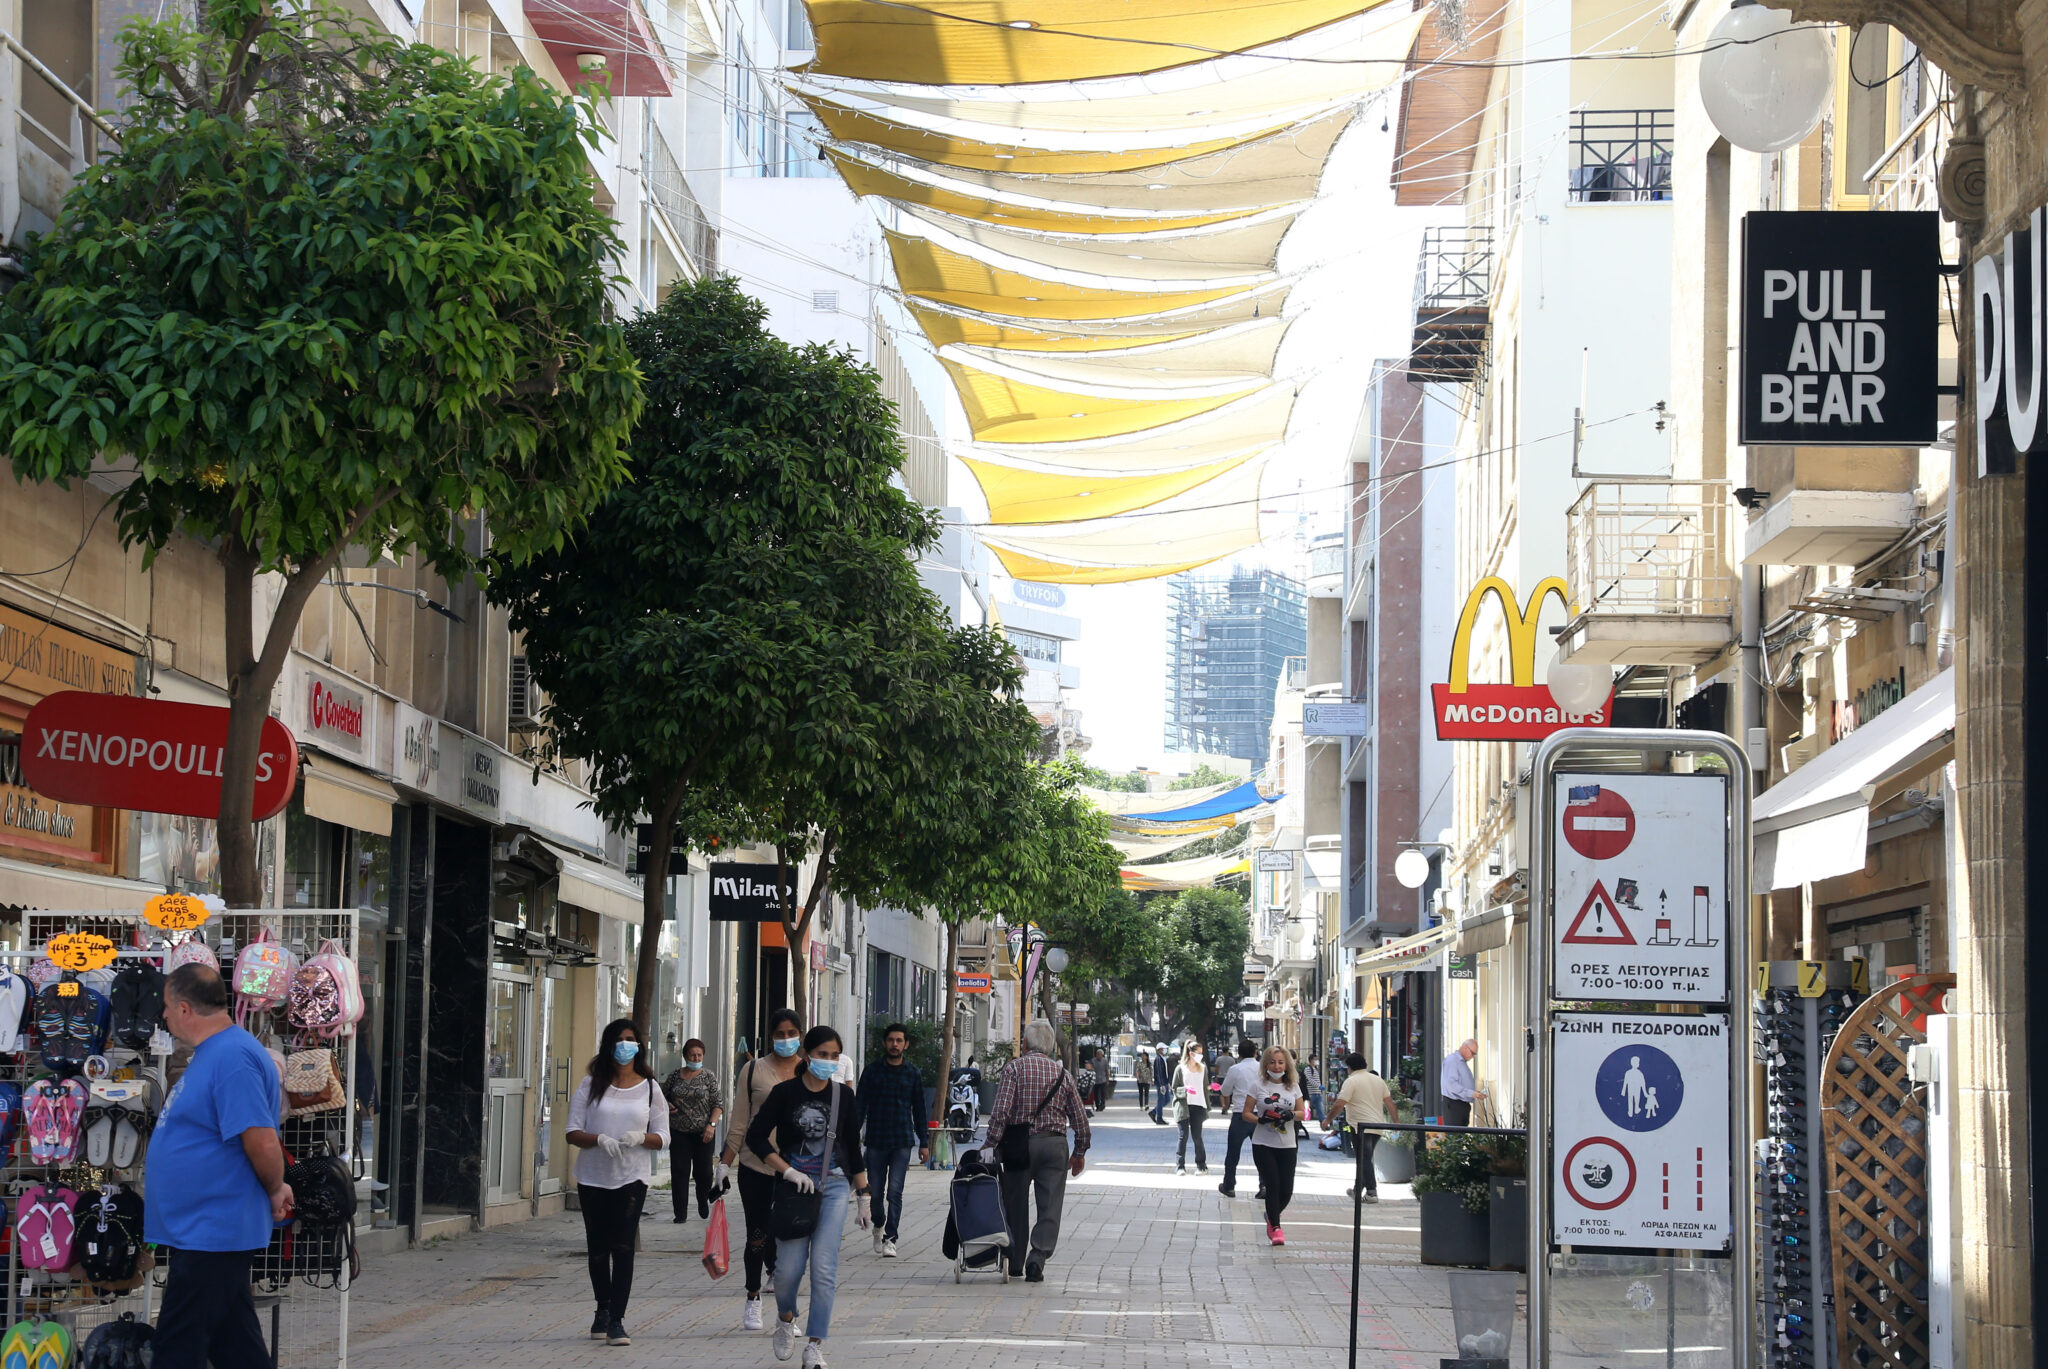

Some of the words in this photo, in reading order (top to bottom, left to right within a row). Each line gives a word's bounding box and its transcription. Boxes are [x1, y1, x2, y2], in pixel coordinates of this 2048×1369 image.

[1763, 269, 1886, 321] PULL
[1787, 322, 1886, 373] AND
[1974, 202, 2048, 479] PU
[1761, 374, 1886, 423] BEAR
[1020, 584, 1059, 603] TRYFON
[101, 661, 133, 696] SHOES
[326, 691, 363, 738] Coverland
[1444, 704, 1605, 725] McDonals
[37, 727, 274, 783] XENOPOULLS
[5, 791, 15, 826] &
[16, 794, 49, 833] Italian
[50, 803, 75, 839] shoes
[159, 904, 189, 916] bags
[1451, 969, 1473, 978] cash
[1570, 963, 1610, 975] ΩΡΕΣ
[1618, 965, 1710, 978] ΛΕΙΤΟΥΡΓΙΑΣ
[1805, 962, 1823, 989] 7
[1580, 977, 1664, 990] 7:00-10:00
[1672, 982, 1700, 993] π.μ.
[1560, 1021, 1603, 1034] ΖΩΝΗ
[1612, 1022, 1720, 1037] ΠΕΖΟΔΡΟΜΩΝ
[1564, 1226, 1583, 1234] 7:00
[1587, 1227, 1610, 1235] 10:00
[1580, 1218, 1611, 1227] ΕΚΤΟΣ:
[1641, 1221, 1669, 1229] ΛΩΡΙΔΑ
[1672, 1222, 1700, 1230] ΠΕΖΩΝ
[1654, 1230, 1704, 1239] ΑΣΦΑΛΕΙΑΣ
